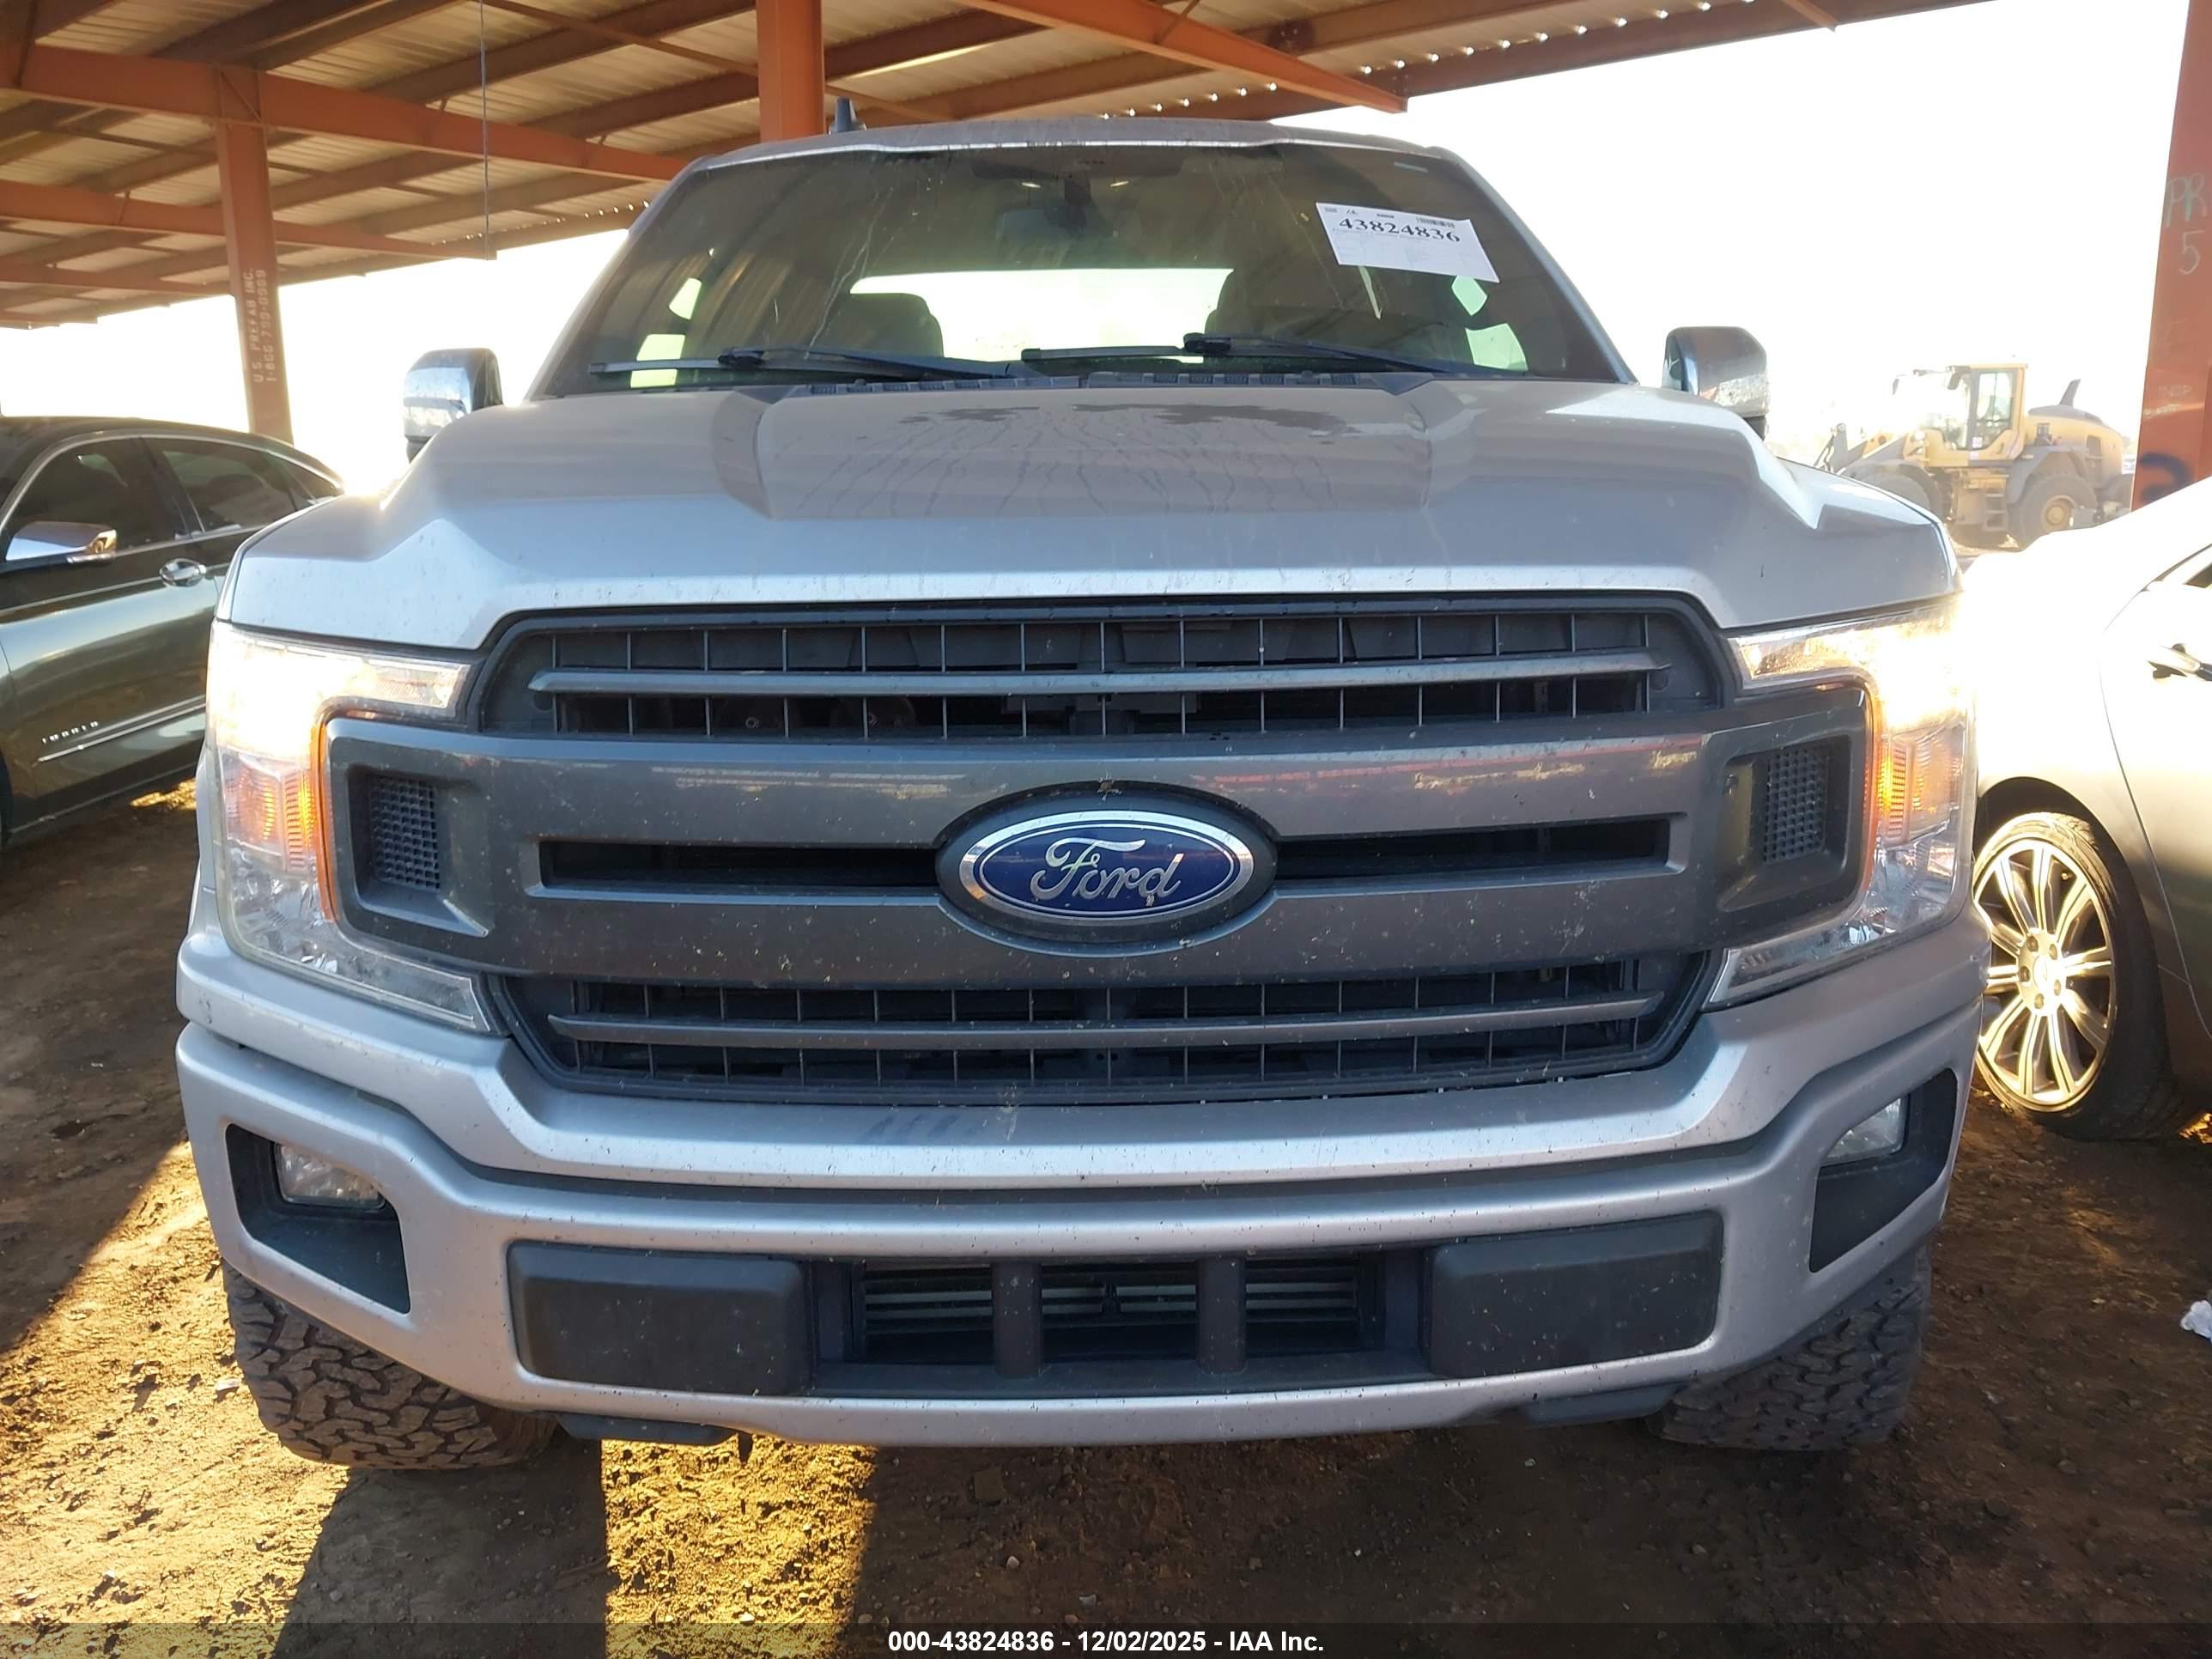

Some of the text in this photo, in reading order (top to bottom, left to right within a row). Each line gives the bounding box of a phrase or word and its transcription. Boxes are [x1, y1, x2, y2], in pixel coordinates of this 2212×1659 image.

[1339, 216, 1461, 242] 43824836
[2179, 229, 2206, 275] 5
[243, 268, 255, 294] INC.
[246, 300, 261, 350] PREFAB
[1030, 836, 1184, 900] Ford
